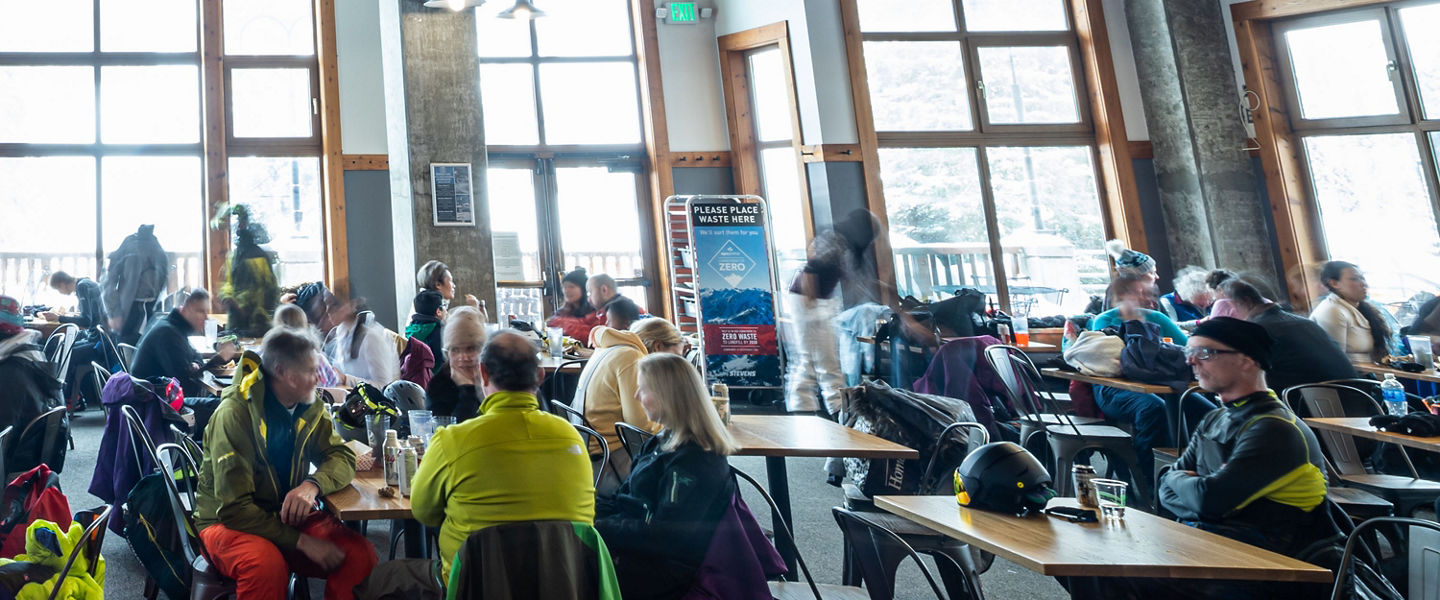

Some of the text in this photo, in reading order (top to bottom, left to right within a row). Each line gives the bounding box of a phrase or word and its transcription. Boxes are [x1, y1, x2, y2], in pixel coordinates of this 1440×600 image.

[671, 3, 695, 21] EXIT
[694, 206, 759, 214] PLEASE PLACE
[699, 215, 756, 223] WASTE HERE
[719, 262, 746, 271] ZERO
